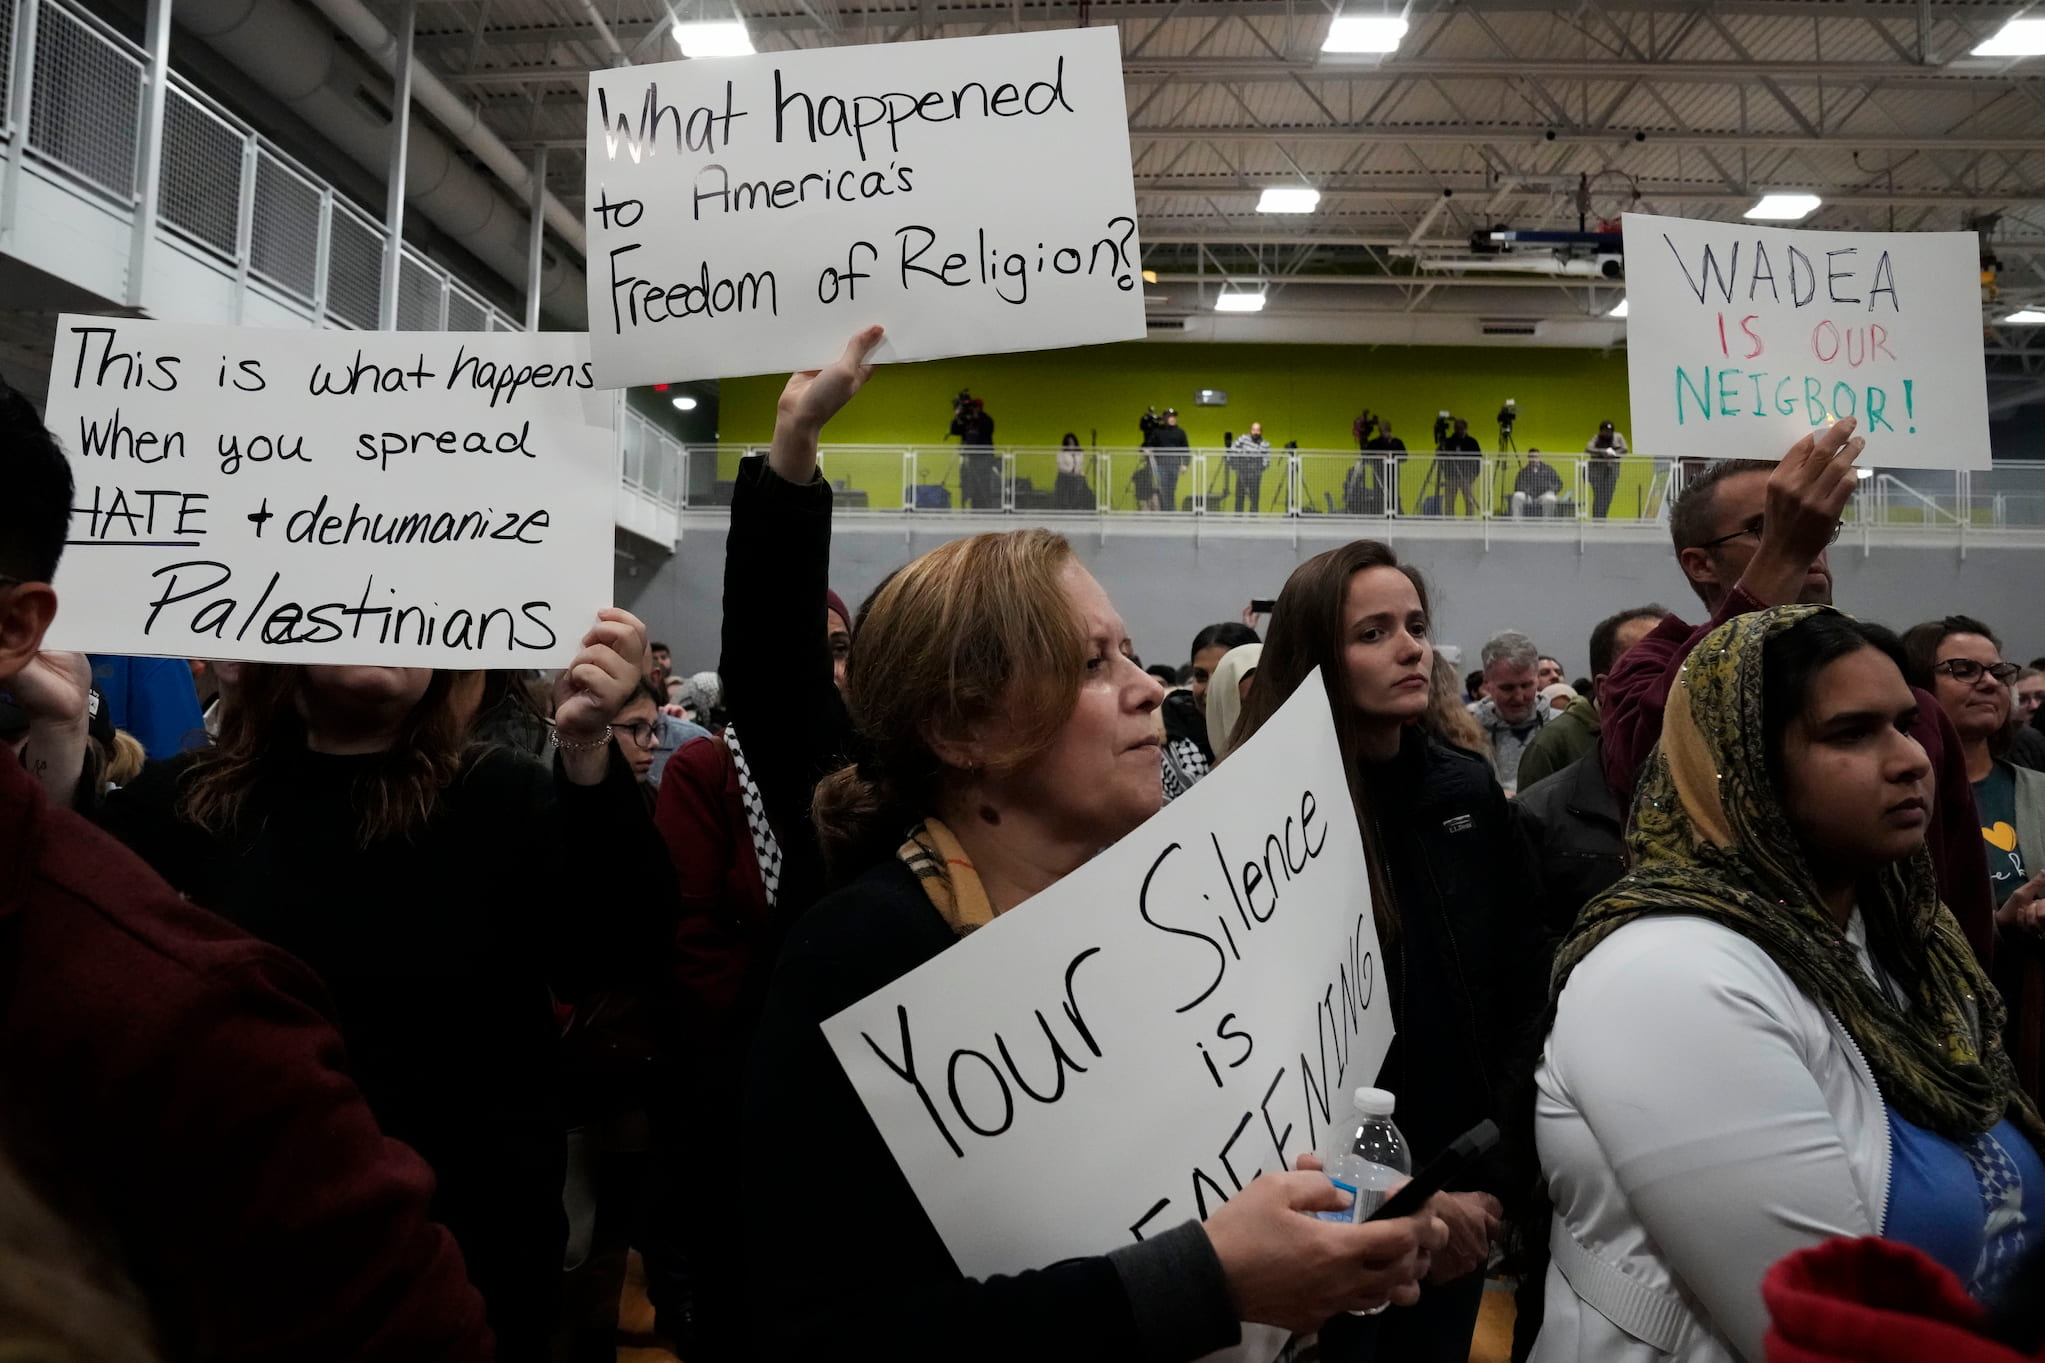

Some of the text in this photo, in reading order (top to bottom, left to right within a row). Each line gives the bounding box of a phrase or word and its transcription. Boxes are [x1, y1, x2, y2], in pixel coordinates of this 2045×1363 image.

[599, 55, 1074, 164] What happened
[593, 161, 913, 229] to America's
[610, 217, 1134, 334] Freedom of Religion?
[1663, 233, 1899, 312] WADEA
[71, 328, 594, 408] This is what happens
[1717, 312, 1897, 367] IS OUR
[1676, 366, 1916, 433] NEIGBOR!
[81, 408, 536, 475] When you spread
[248, 498, 273, 538] +
[286, 495, 549, 545] dehumanize
[861, 790, 1328, 1158] Your Silence
[1196, 1013, 1253, 1088] is
